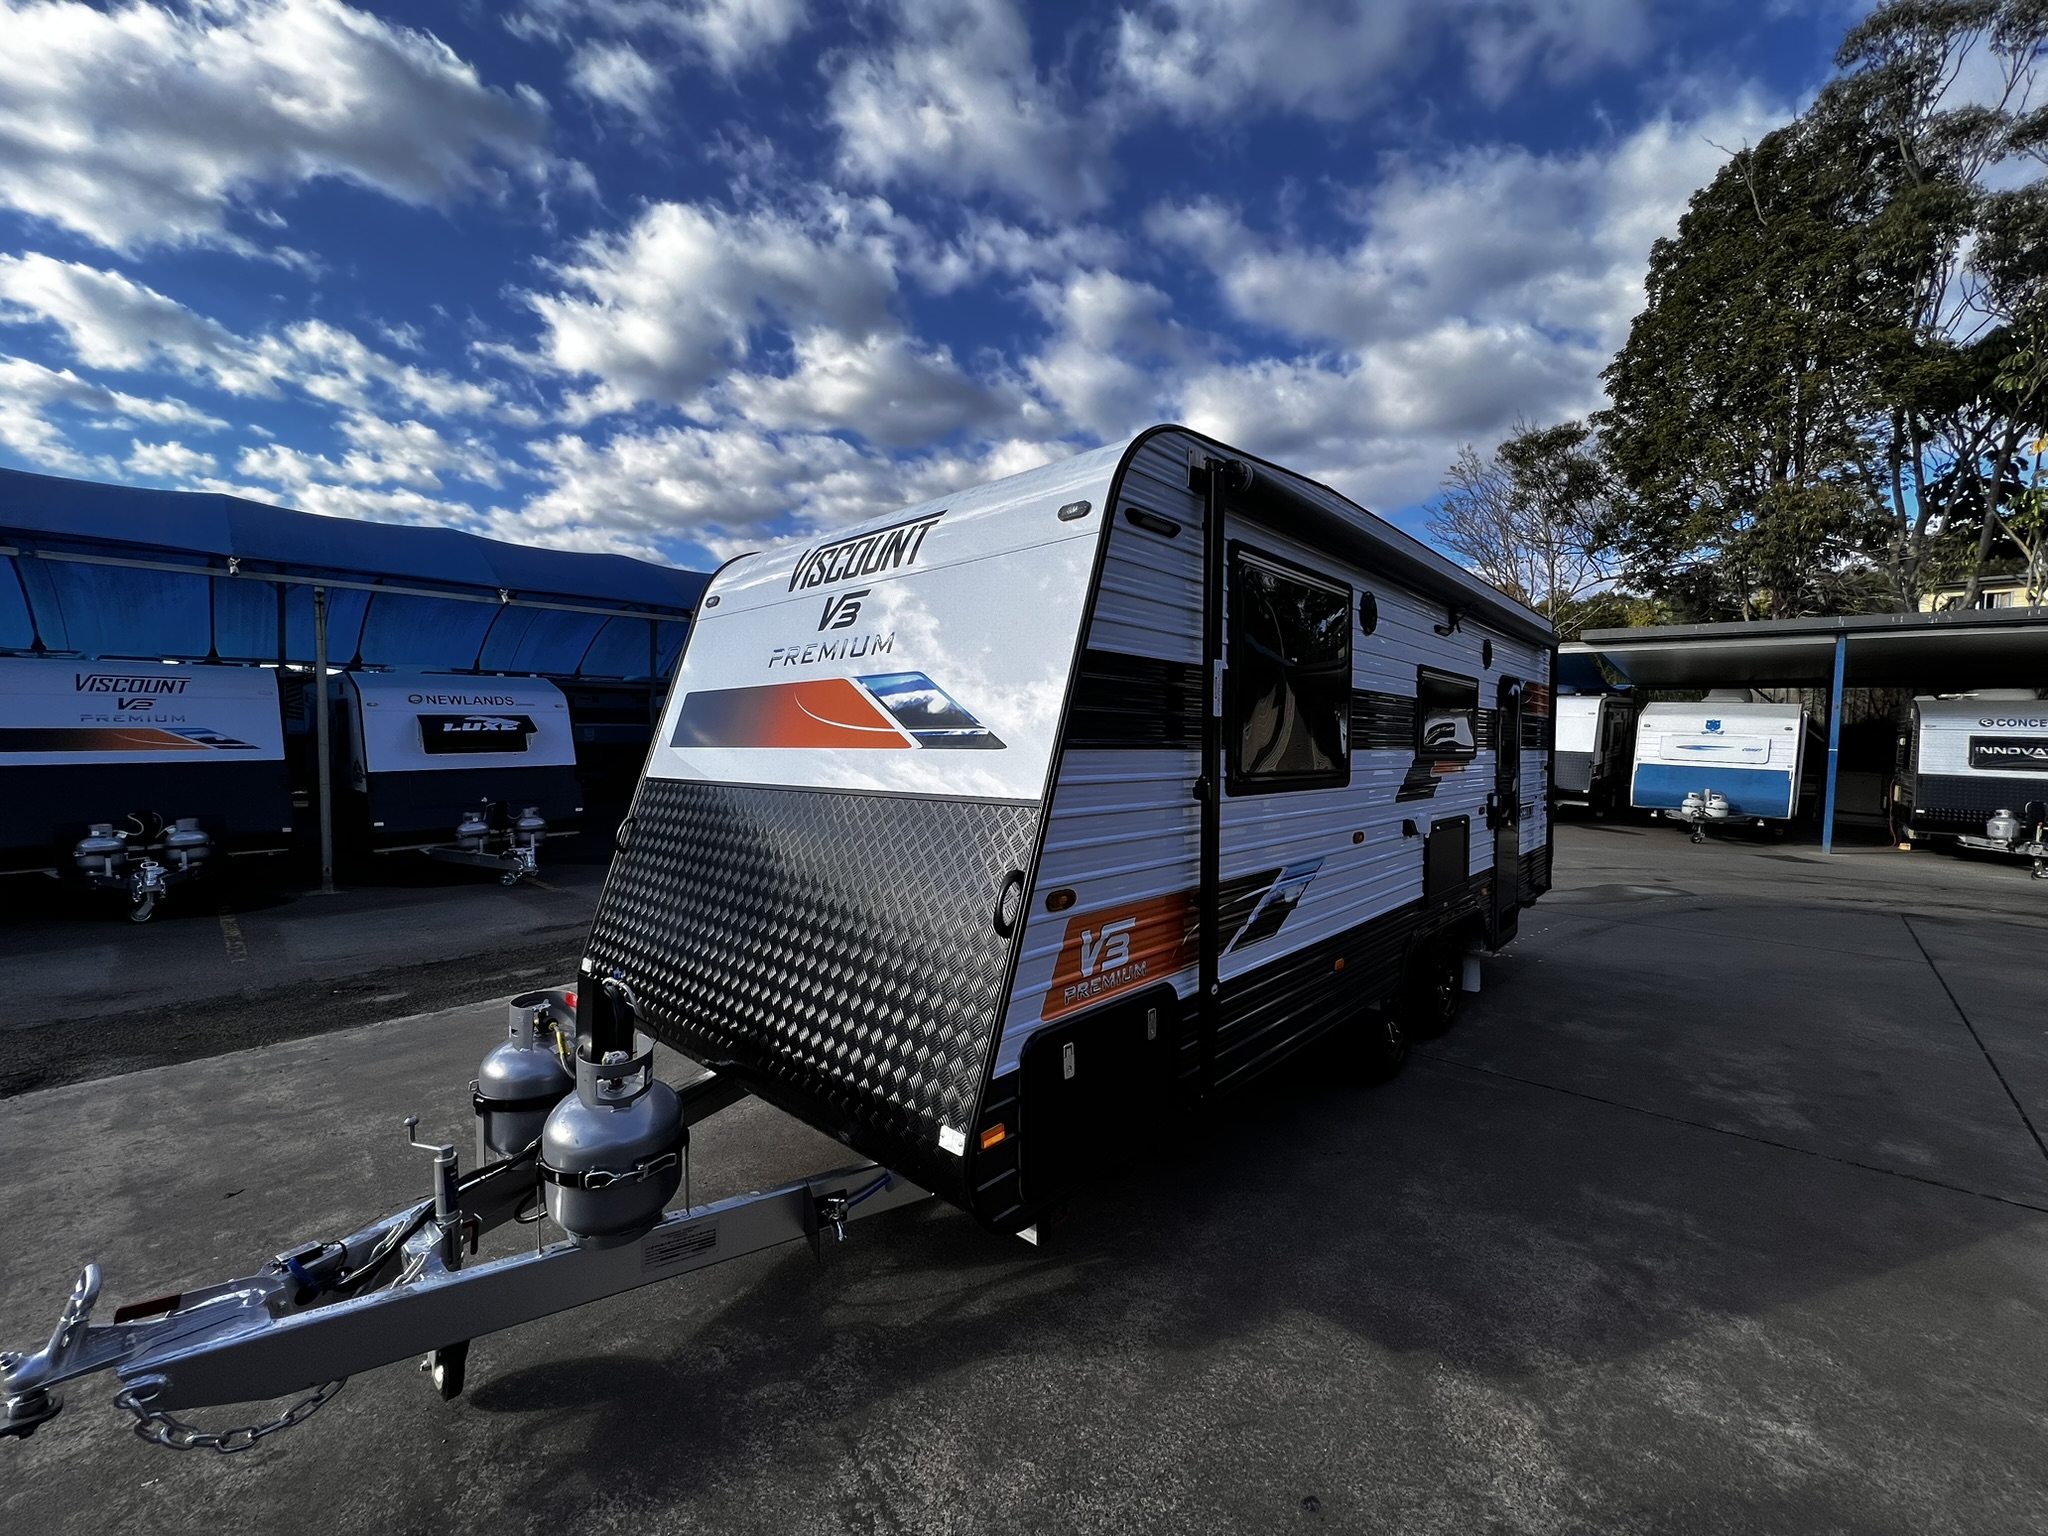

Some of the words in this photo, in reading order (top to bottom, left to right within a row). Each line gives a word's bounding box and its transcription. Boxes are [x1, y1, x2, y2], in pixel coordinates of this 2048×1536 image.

[788, 509, 948, 592] VISCOUNT
[818, 589, 871, 631] V3
[768, 632, 895, 668] PREMIUM
[76, 674, 191, 694] VISCOUNT
[118, 698, 156, 710] V2
[424, 695, 514, 706] NEWLANDS
[80, 714, 185, 722] PREMIUM
[443, 721, 520, 731] LUXE
[1975, 746, 2048, 756] INNOVA
[1081, 917, 1136, 977] V3
[1065, 961, 1146, 1005] PREMIUM
